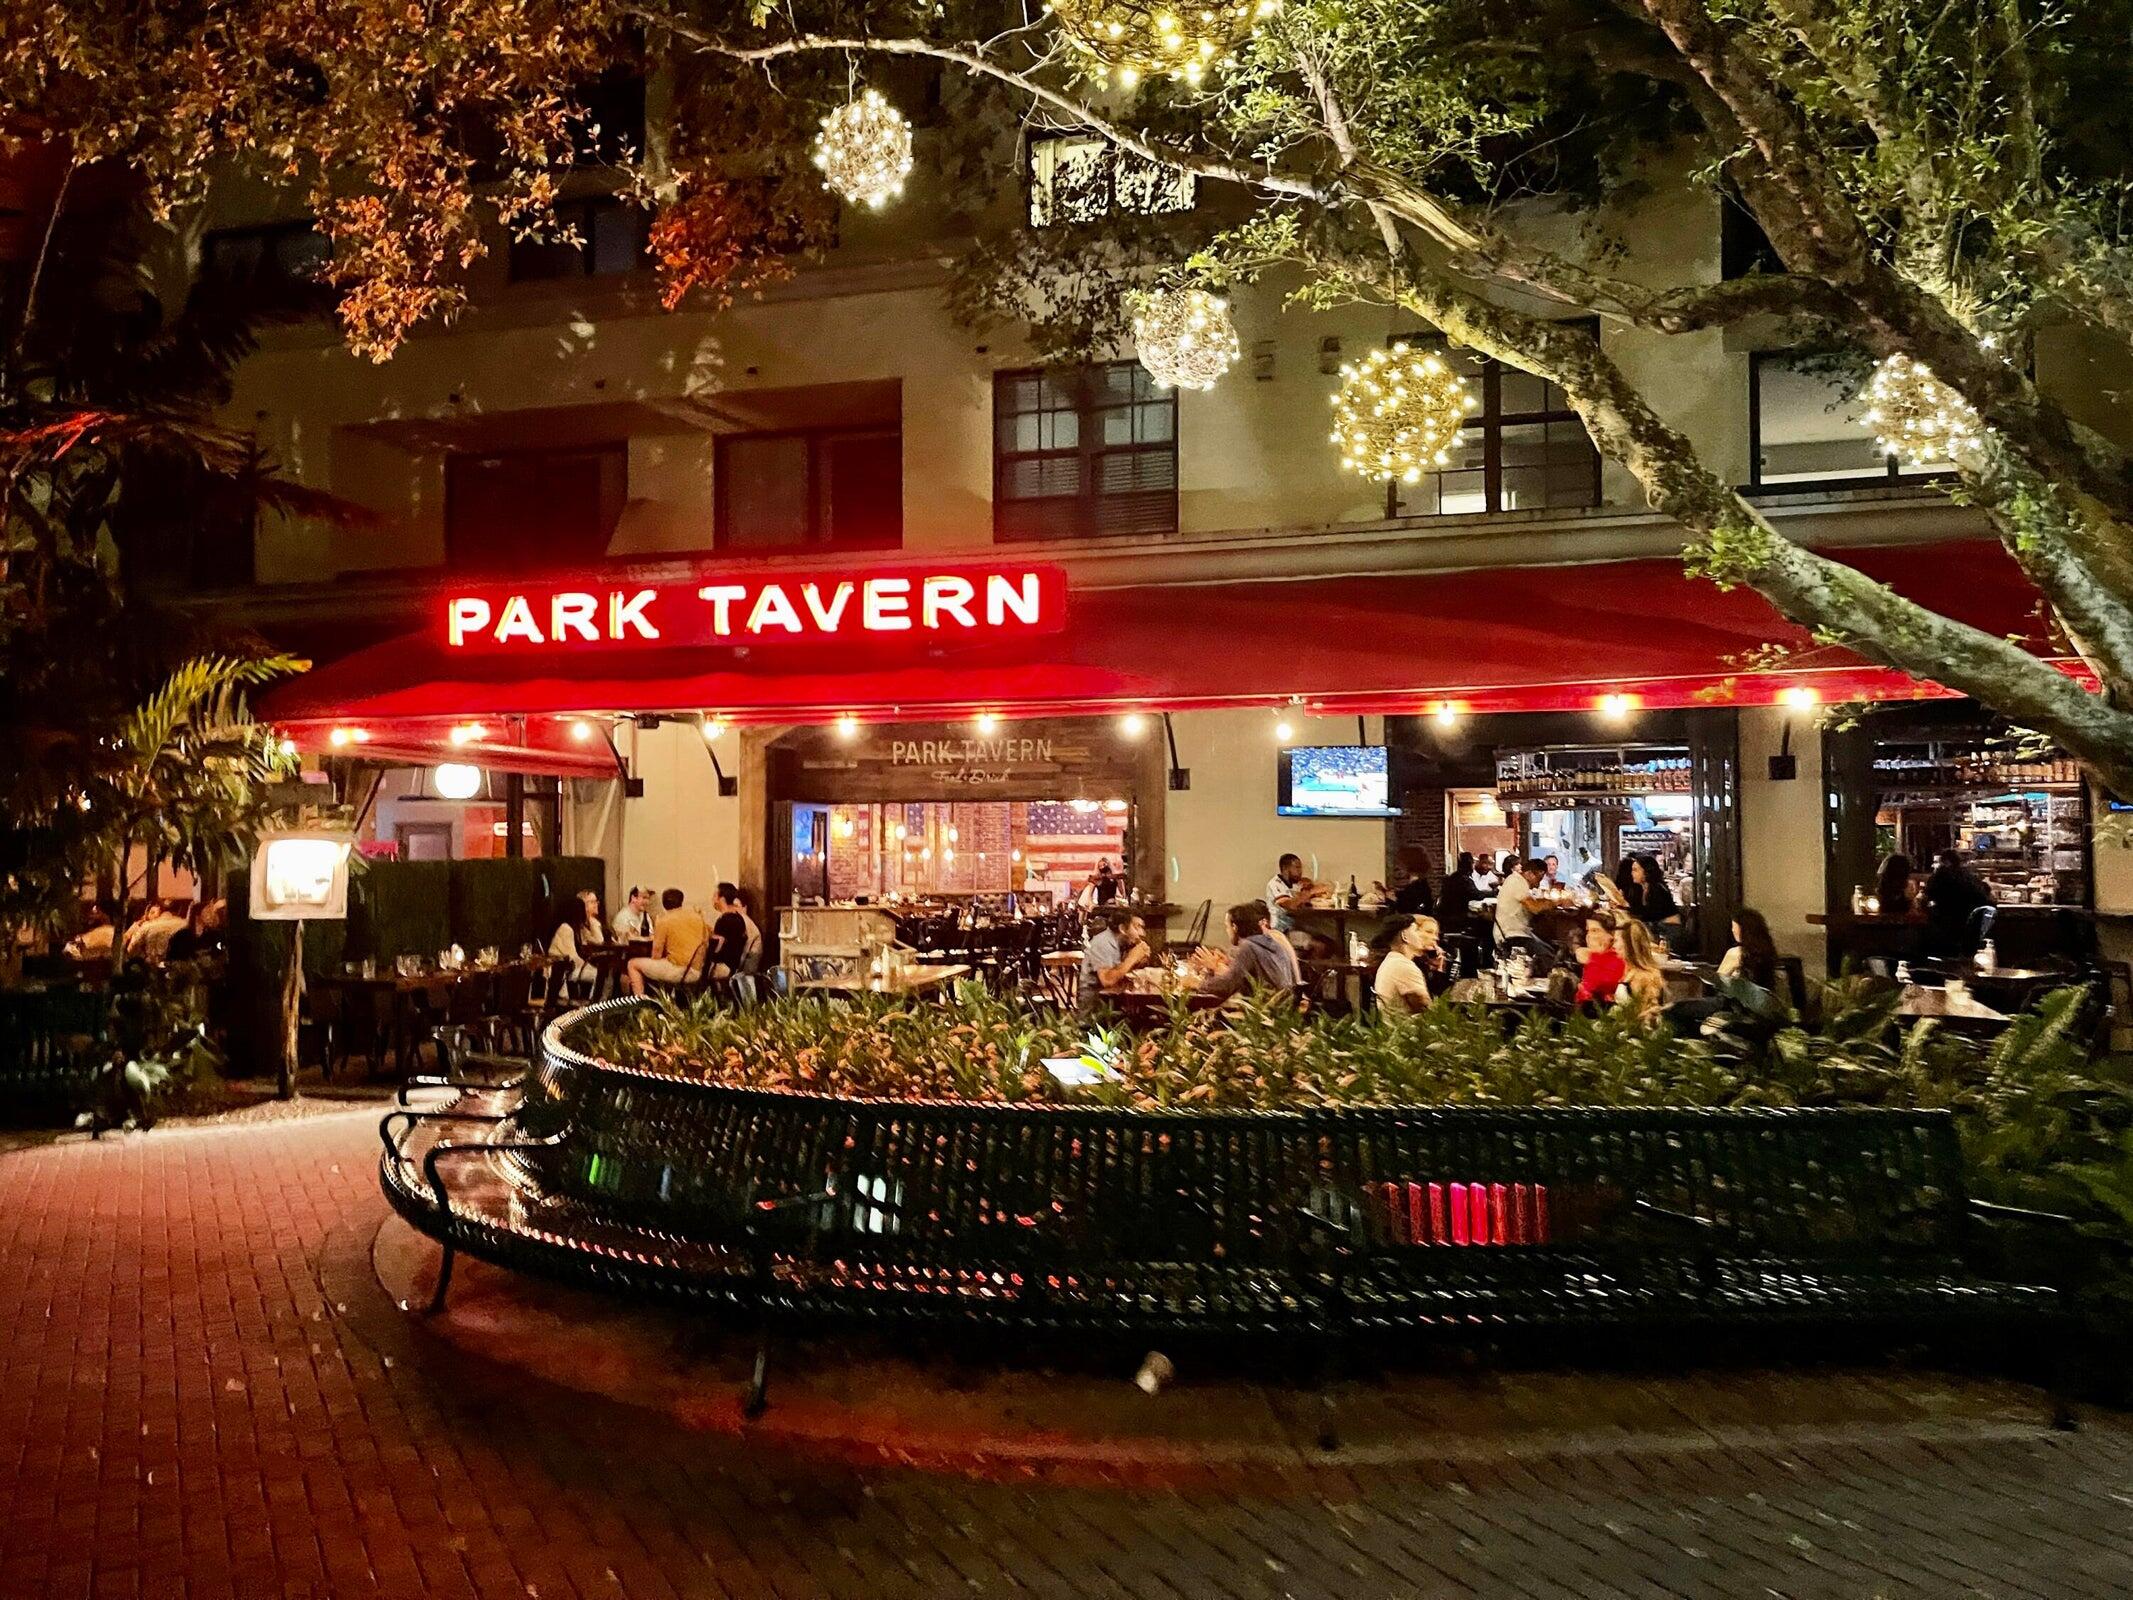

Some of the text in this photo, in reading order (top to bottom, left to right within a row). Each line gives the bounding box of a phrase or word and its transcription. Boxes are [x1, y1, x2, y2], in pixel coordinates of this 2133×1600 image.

[449, 573, 1040, 646] PARK TAVERN
[892, 738, 1053, 765] PARK TAVERN
